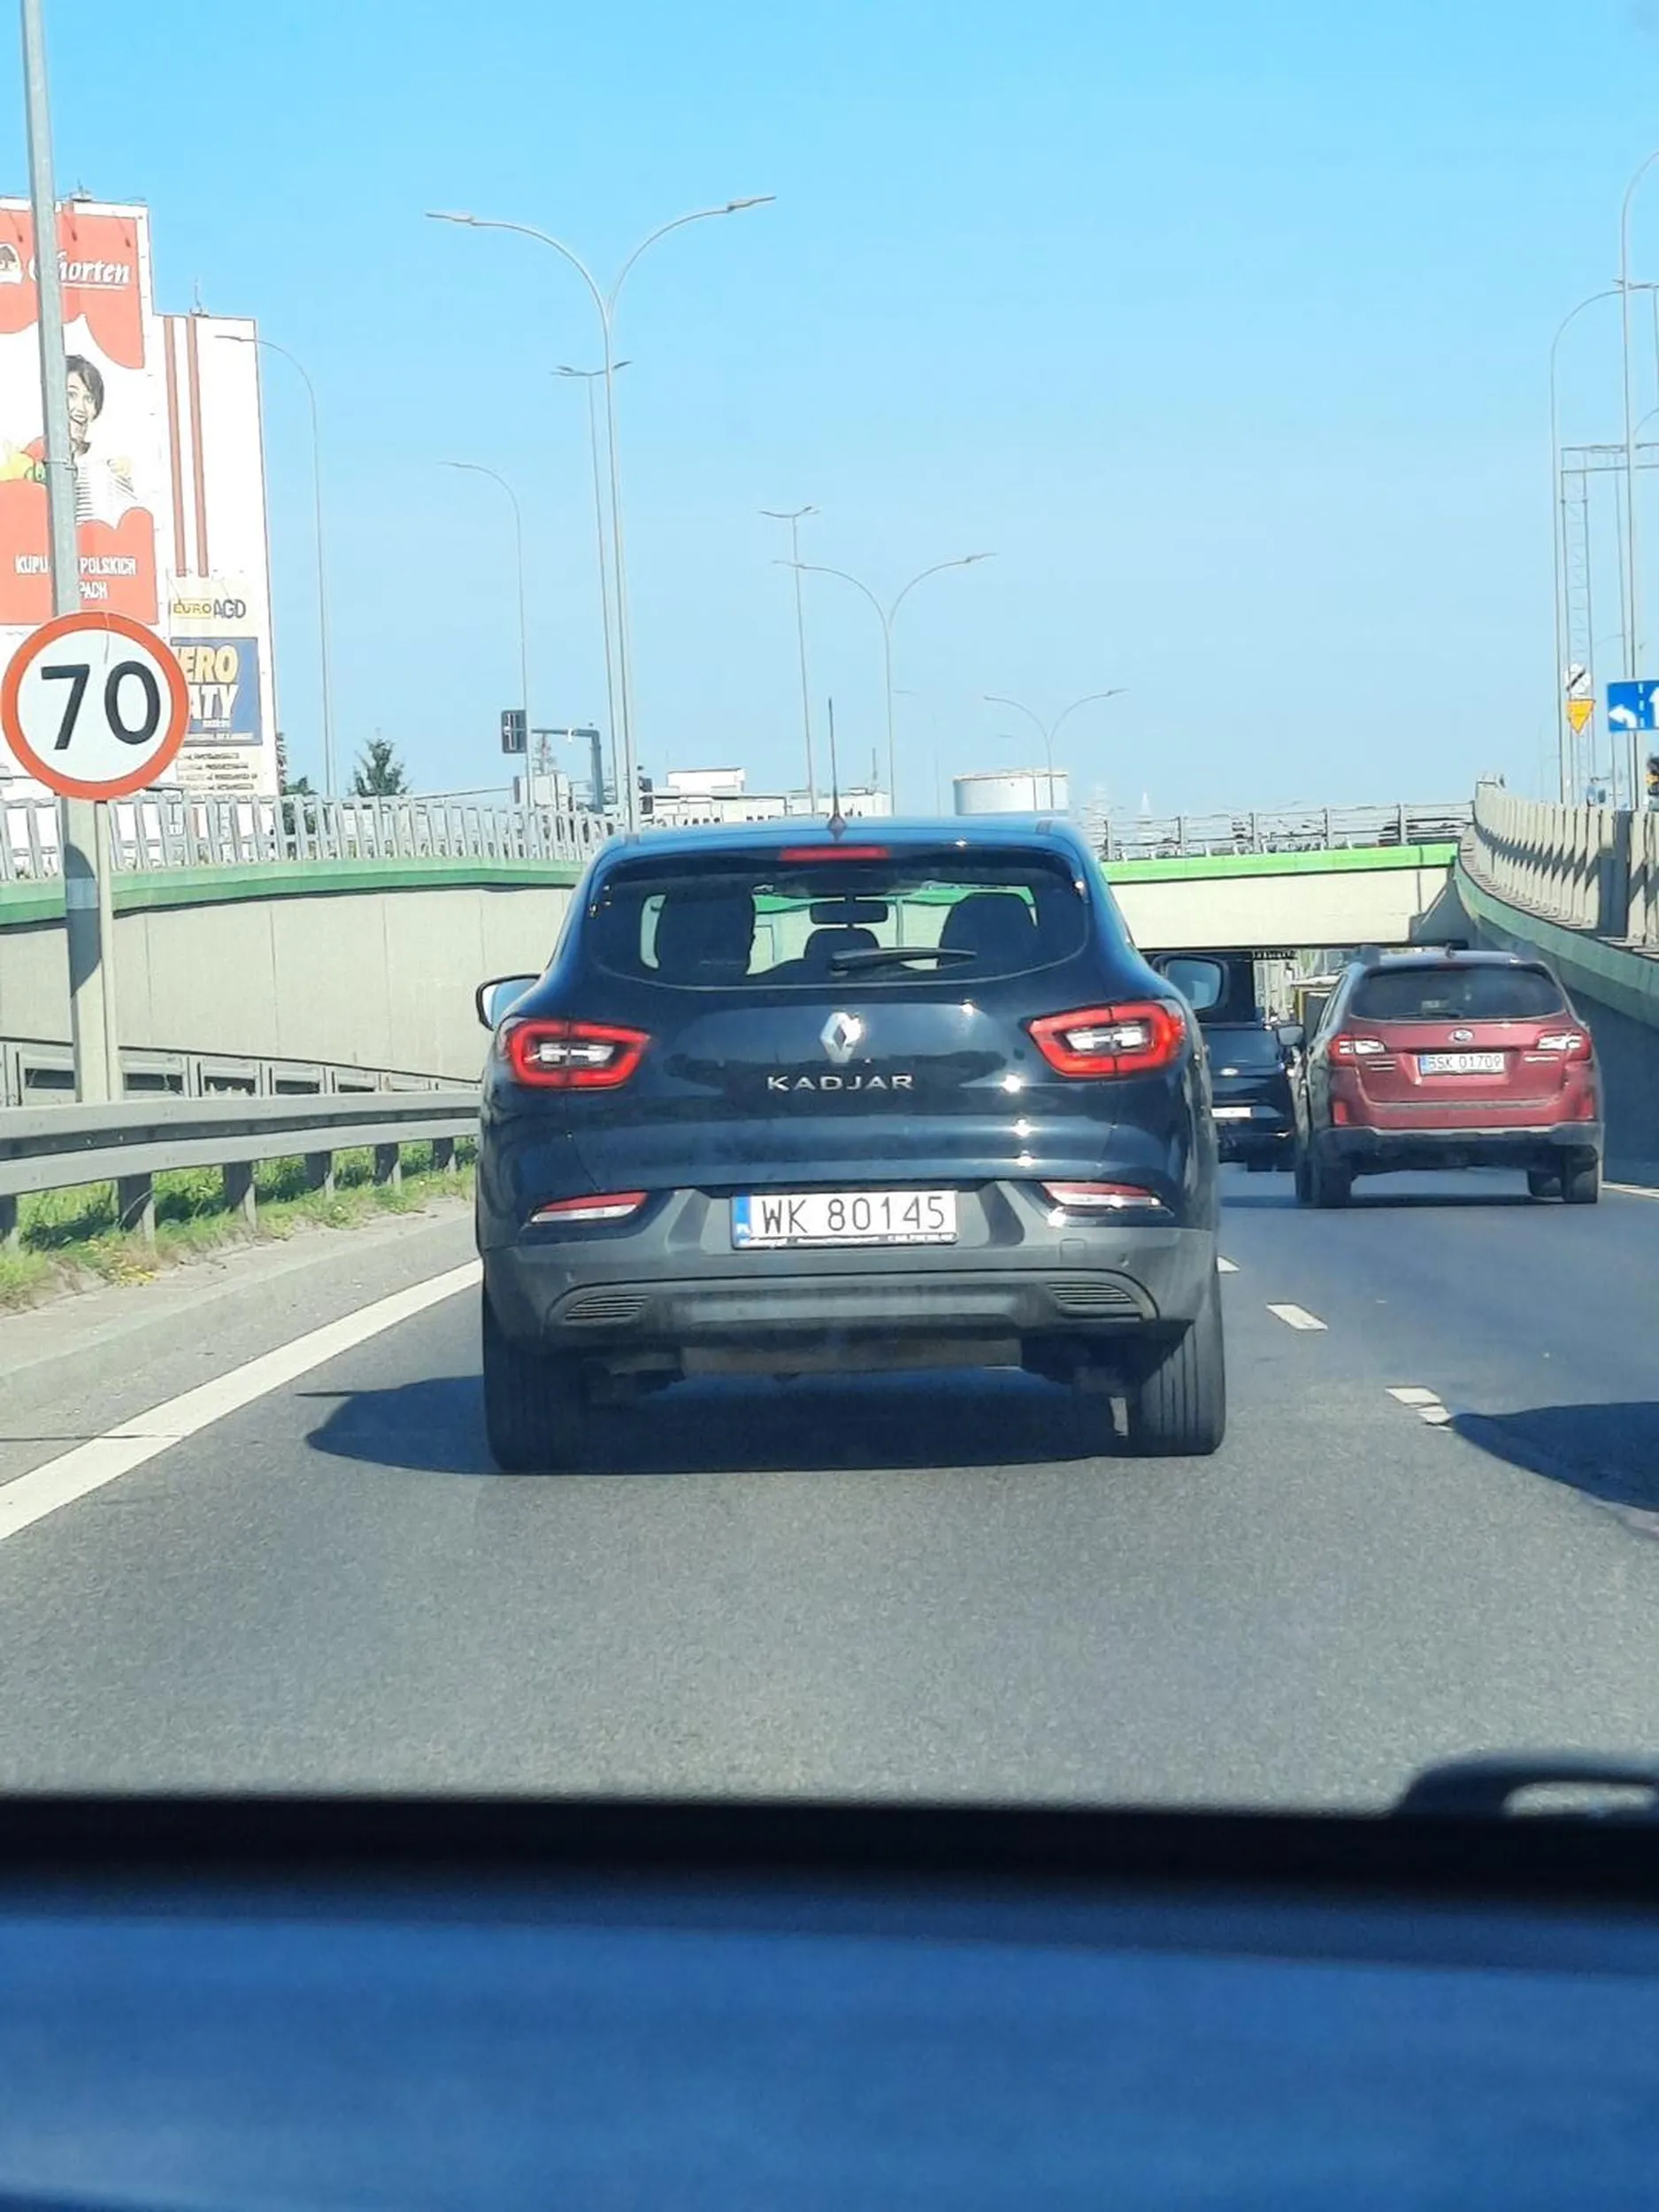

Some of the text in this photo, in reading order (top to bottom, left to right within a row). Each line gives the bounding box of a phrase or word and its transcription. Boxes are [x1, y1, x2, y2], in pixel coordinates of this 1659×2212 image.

[15, 555, 50, 573] KUPU
[173, 598, 246, 618] EURO AGD
[41, 660, 161, 750] 70
[189, 685, 239, 719] ATY
[767, 1075, 913, 1091] KADJAR
[762, 1196, 944, 1233] WK 80145
